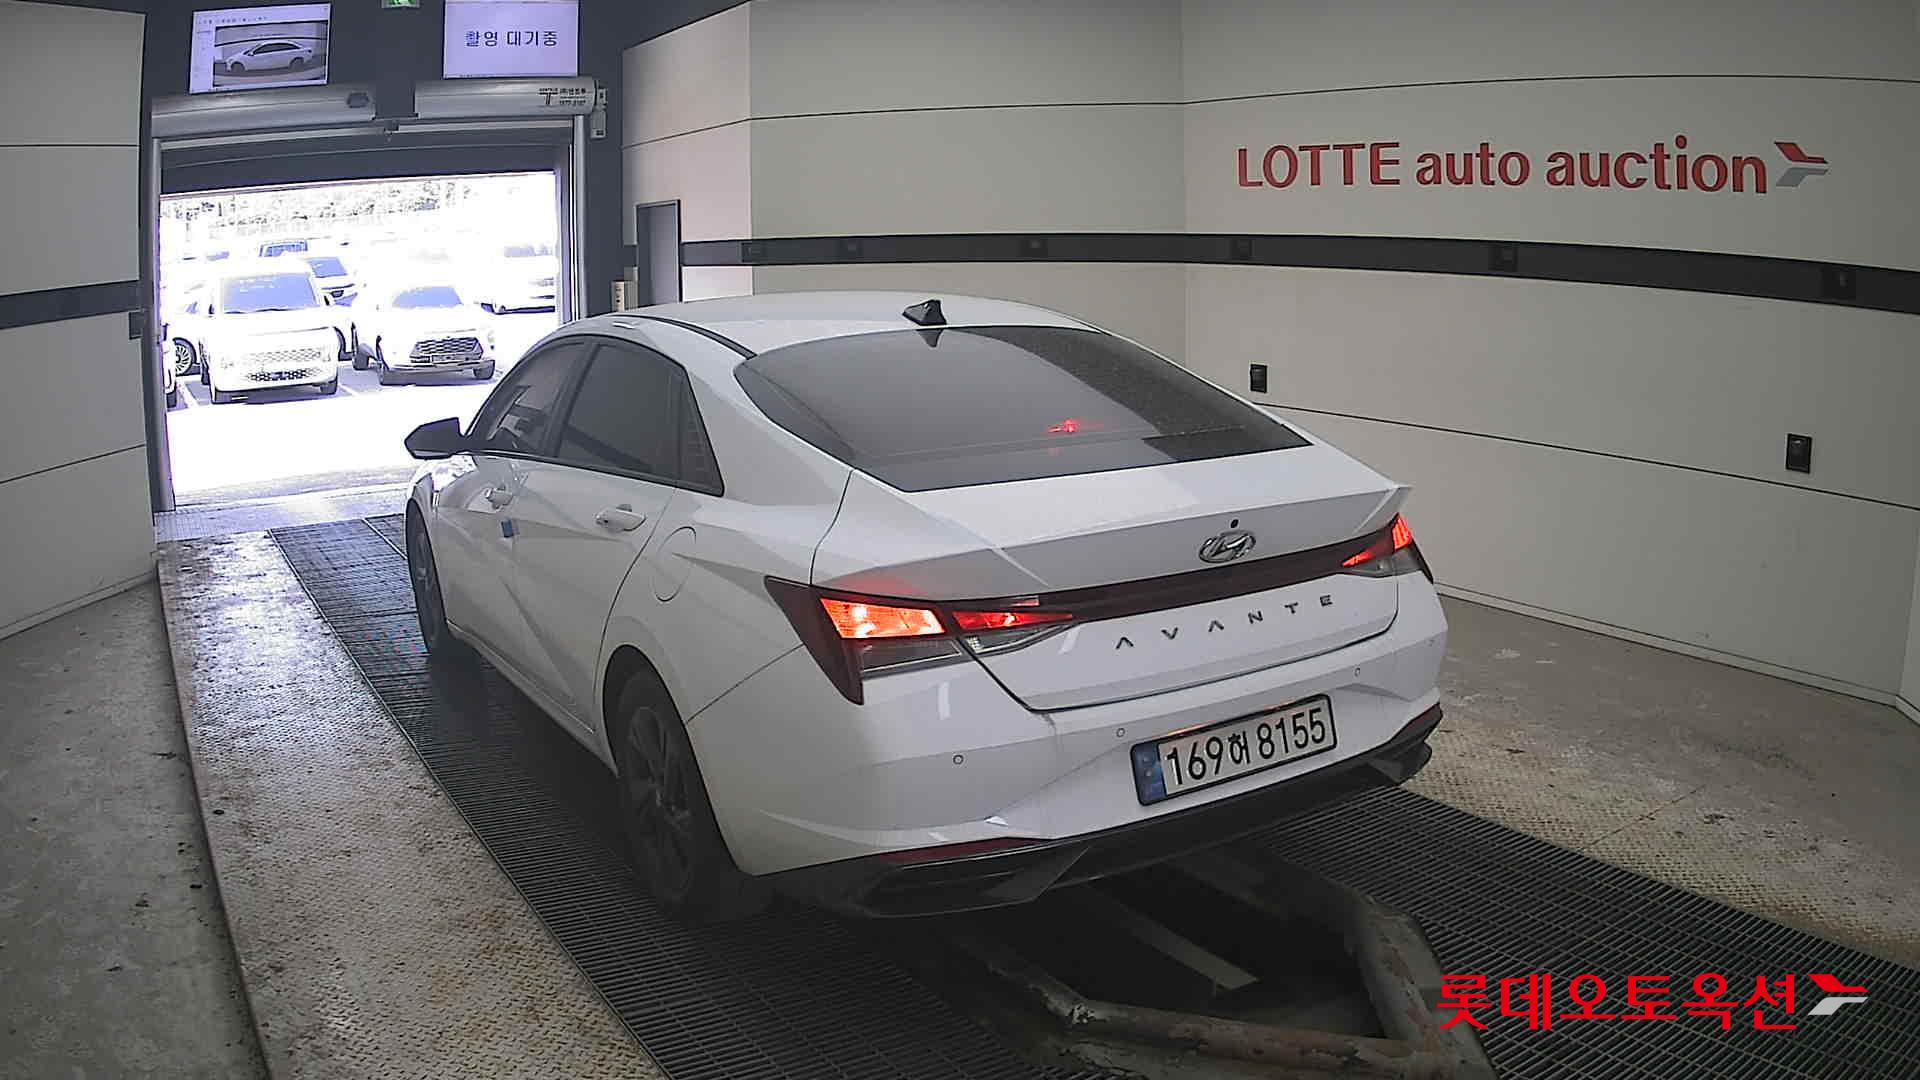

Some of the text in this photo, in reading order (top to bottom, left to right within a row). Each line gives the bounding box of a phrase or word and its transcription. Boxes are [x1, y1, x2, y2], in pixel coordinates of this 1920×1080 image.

[465, 30, 498, 47] 촬영
[1238, 134, 1767, 194] LOTTE auto auction
[1115, 594, 1333, 650] AVANTE
[1166, 707, 1326, 786] 169허 8155
